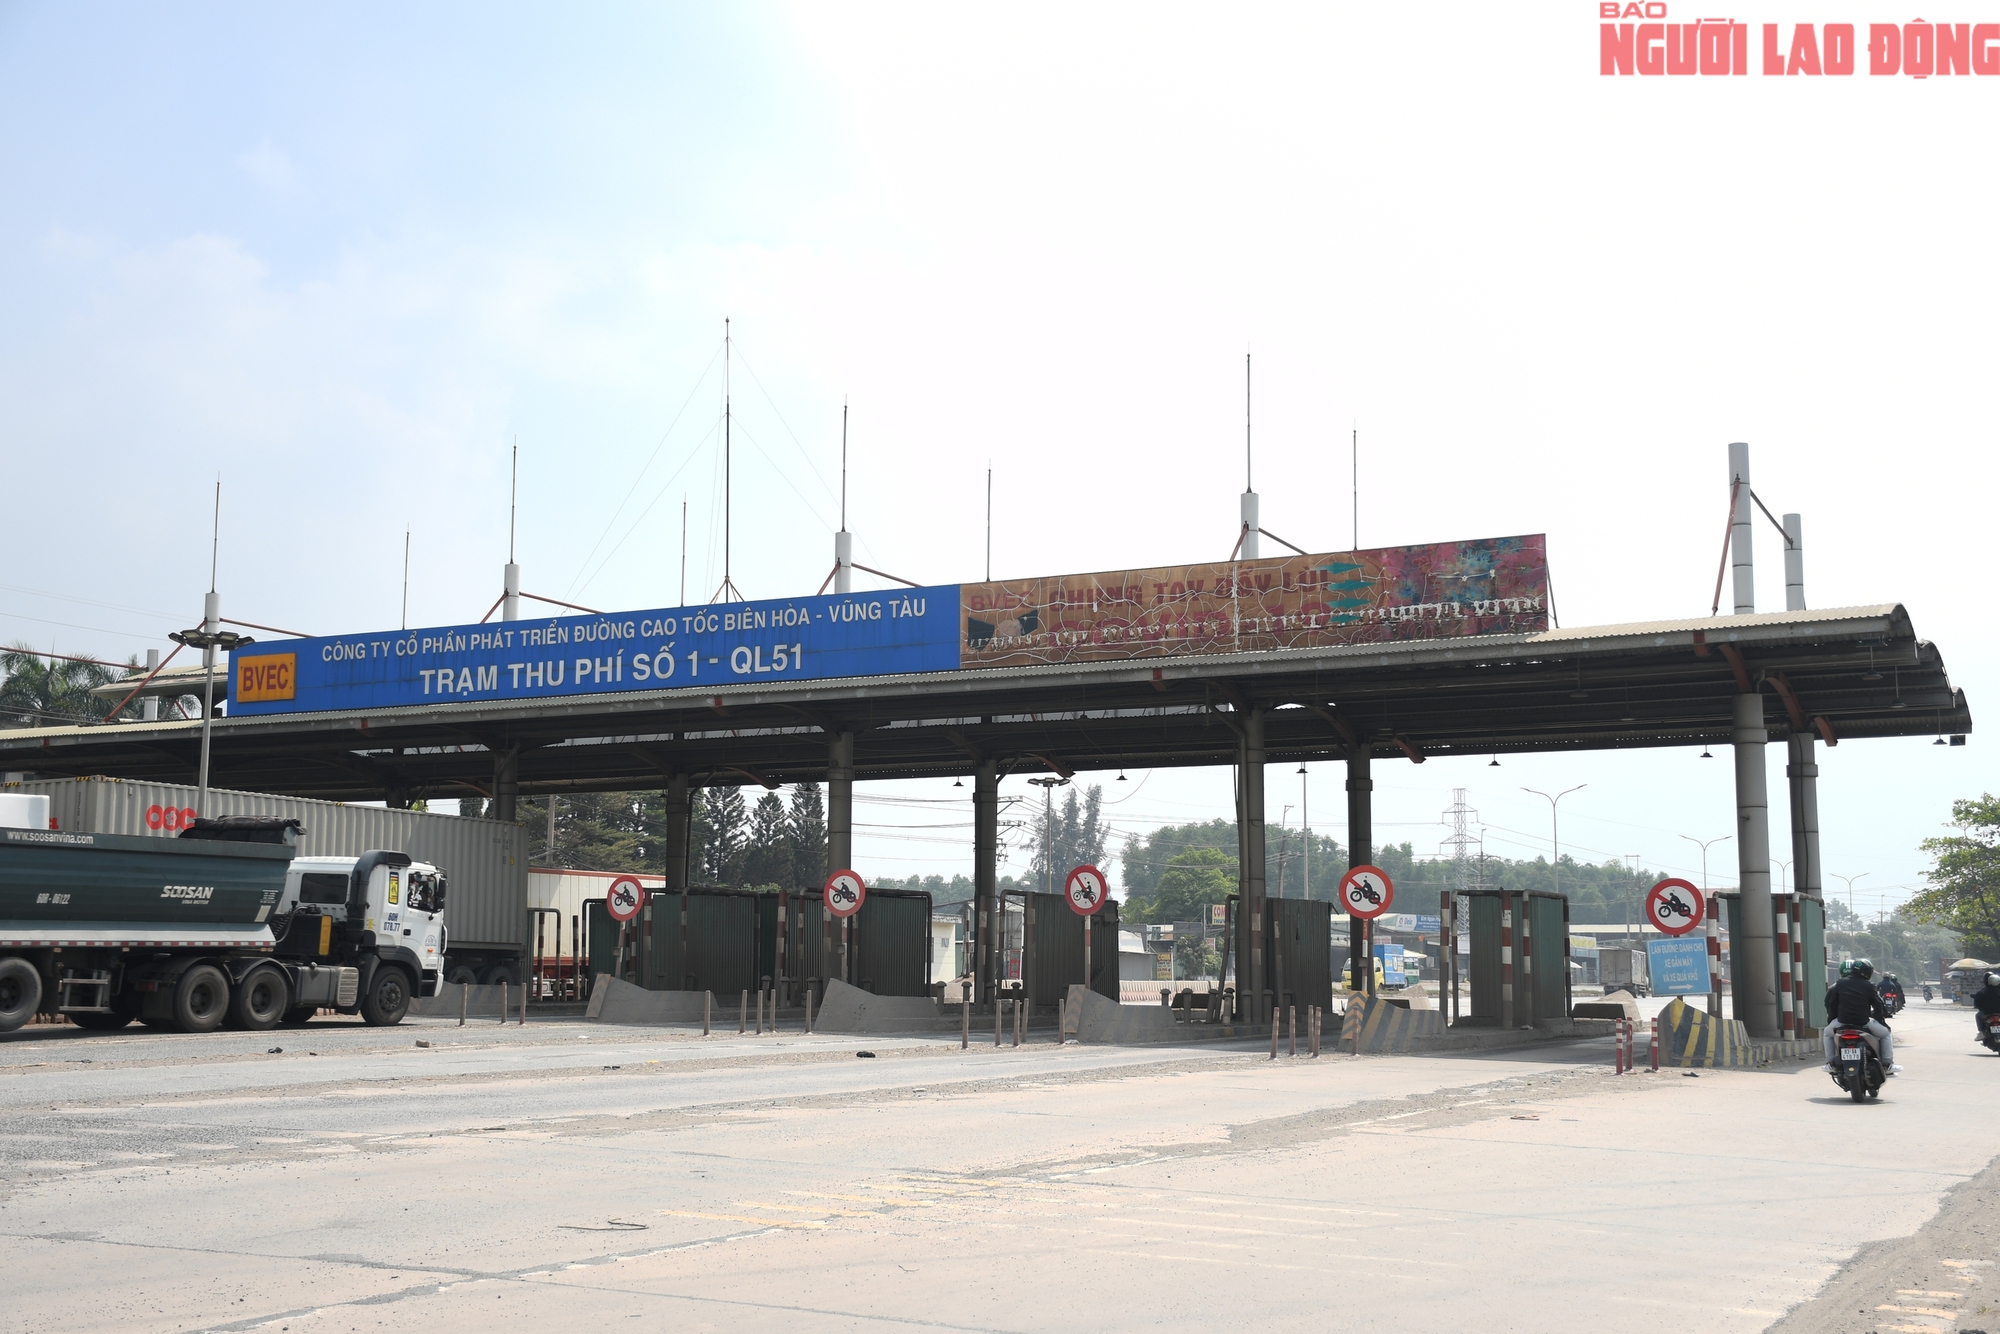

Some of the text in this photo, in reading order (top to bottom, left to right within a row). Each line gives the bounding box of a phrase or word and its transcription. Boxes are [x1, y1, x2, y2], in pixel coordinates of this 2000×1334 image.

[970, 590, 1034, 611] BVEC
[1049, 584, 1142, 612] CHUNG
[322, 640, 366, 662] CÔNG
[371, 641, 391, 658] TY
[395, 630, 418, 657] CỔ
[422, 630, 467, 655] PHẦN
[471, 627, 514, 650] PHÁT
[520, 619, 569, 647] TRIỂN
[574, 616, 635, 643] ĐƯỜNG
[640, 617, 677, 638] CAO
[683, 608, 719, 634] TỐC
[724, 607, 767, 632] BIÊN
[771, 602, 811, 628] HÒA
[829, 600, 882, 624] VŨNG
[888, 598, 926, 618] TÀU
[242, 663, 290, 692] BVEC
[420, 665, 498, 696] TRẠM
[508, 658, 566, 689] THU
[575, 648, 624, 685] PHÍ
[632, 642, 675, 682] SỐ
[687, 650, 698, 677] 1
[730, 643, 802, 675] QL51
[145, 804, 198, 832] OOC
[7, 831, 94, 844] www.soosanvina.com
[160, 885, 214, 899] SOOSAN
[1651, 943, 1661, 954] LÀN
[1694, 943, 1703, 952] CHO
[1664, 958, 1671, 968] XE
[1683, 956, 1693, 967] MÁY
[1670, 972, 1677, 982] XE
